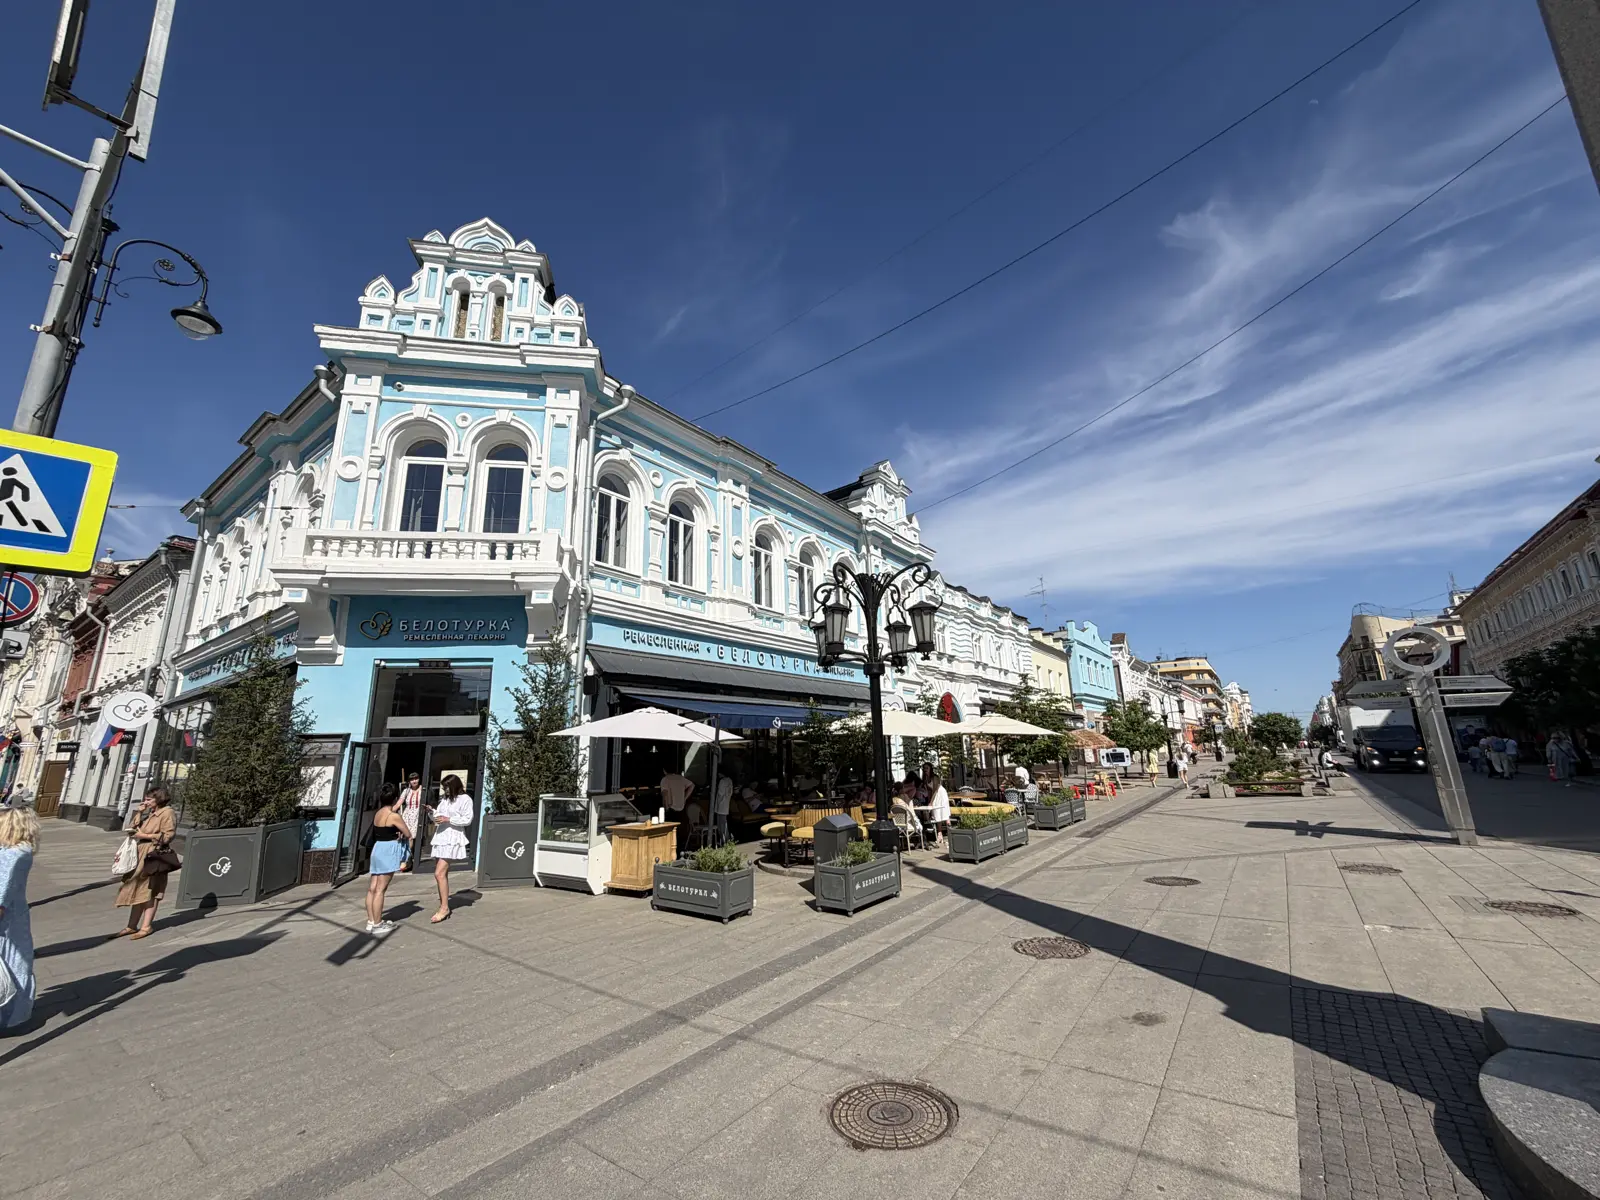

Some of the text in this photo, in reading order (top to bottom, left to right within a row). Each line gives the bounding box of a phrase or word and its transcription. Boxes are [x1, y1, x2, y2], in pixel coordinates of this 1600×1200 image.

[399, 619, 511, 631] БЕЛОТУРКА
[467, 633, 506, 641] ПЕКАРНЯ
[623, 629, 700, 654] РЕМЕСЛЕННАЯ
[717, 644, 821, 674] БЕЛОТУРКА
[667, 883, 708, 897] БЕЛОТУРКА
